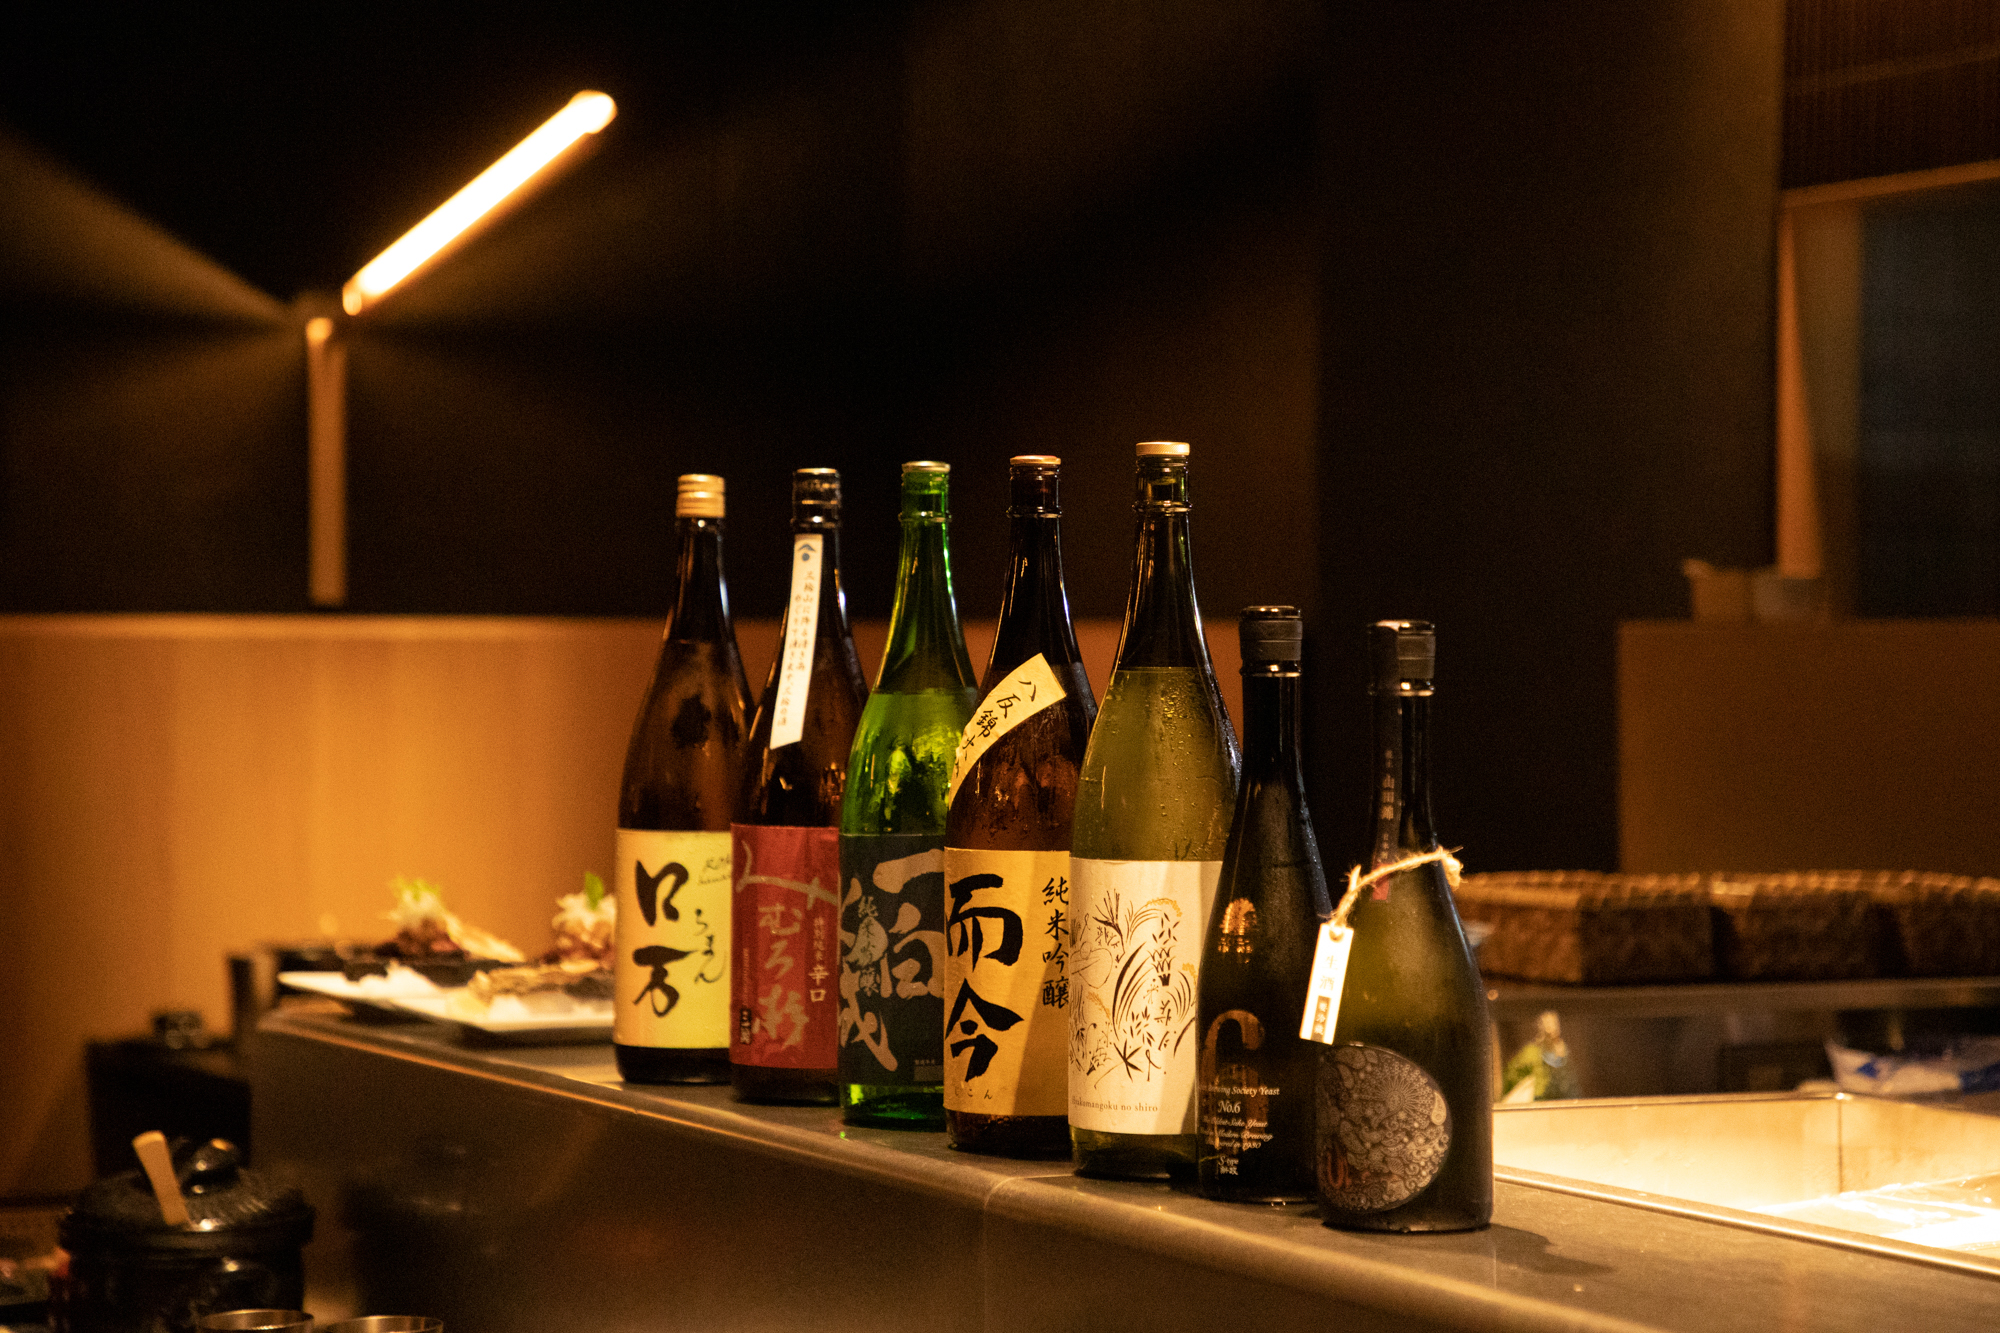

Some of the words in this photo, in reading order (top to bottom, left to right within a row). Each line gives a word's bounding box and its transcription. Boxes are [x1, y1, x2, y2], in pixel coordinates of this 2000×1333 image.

[1042, 876, 1069, 1009] 純米吟醸
[945, 873, 1025, 1083] 而今
[1231, 1086, 1257, 1098] Society
[1260, 1086, 1280, 1096] Yeast
[1134, 1102, 1158, 1112] shiro
[1218, 1100, 1241, 1114] No.6
